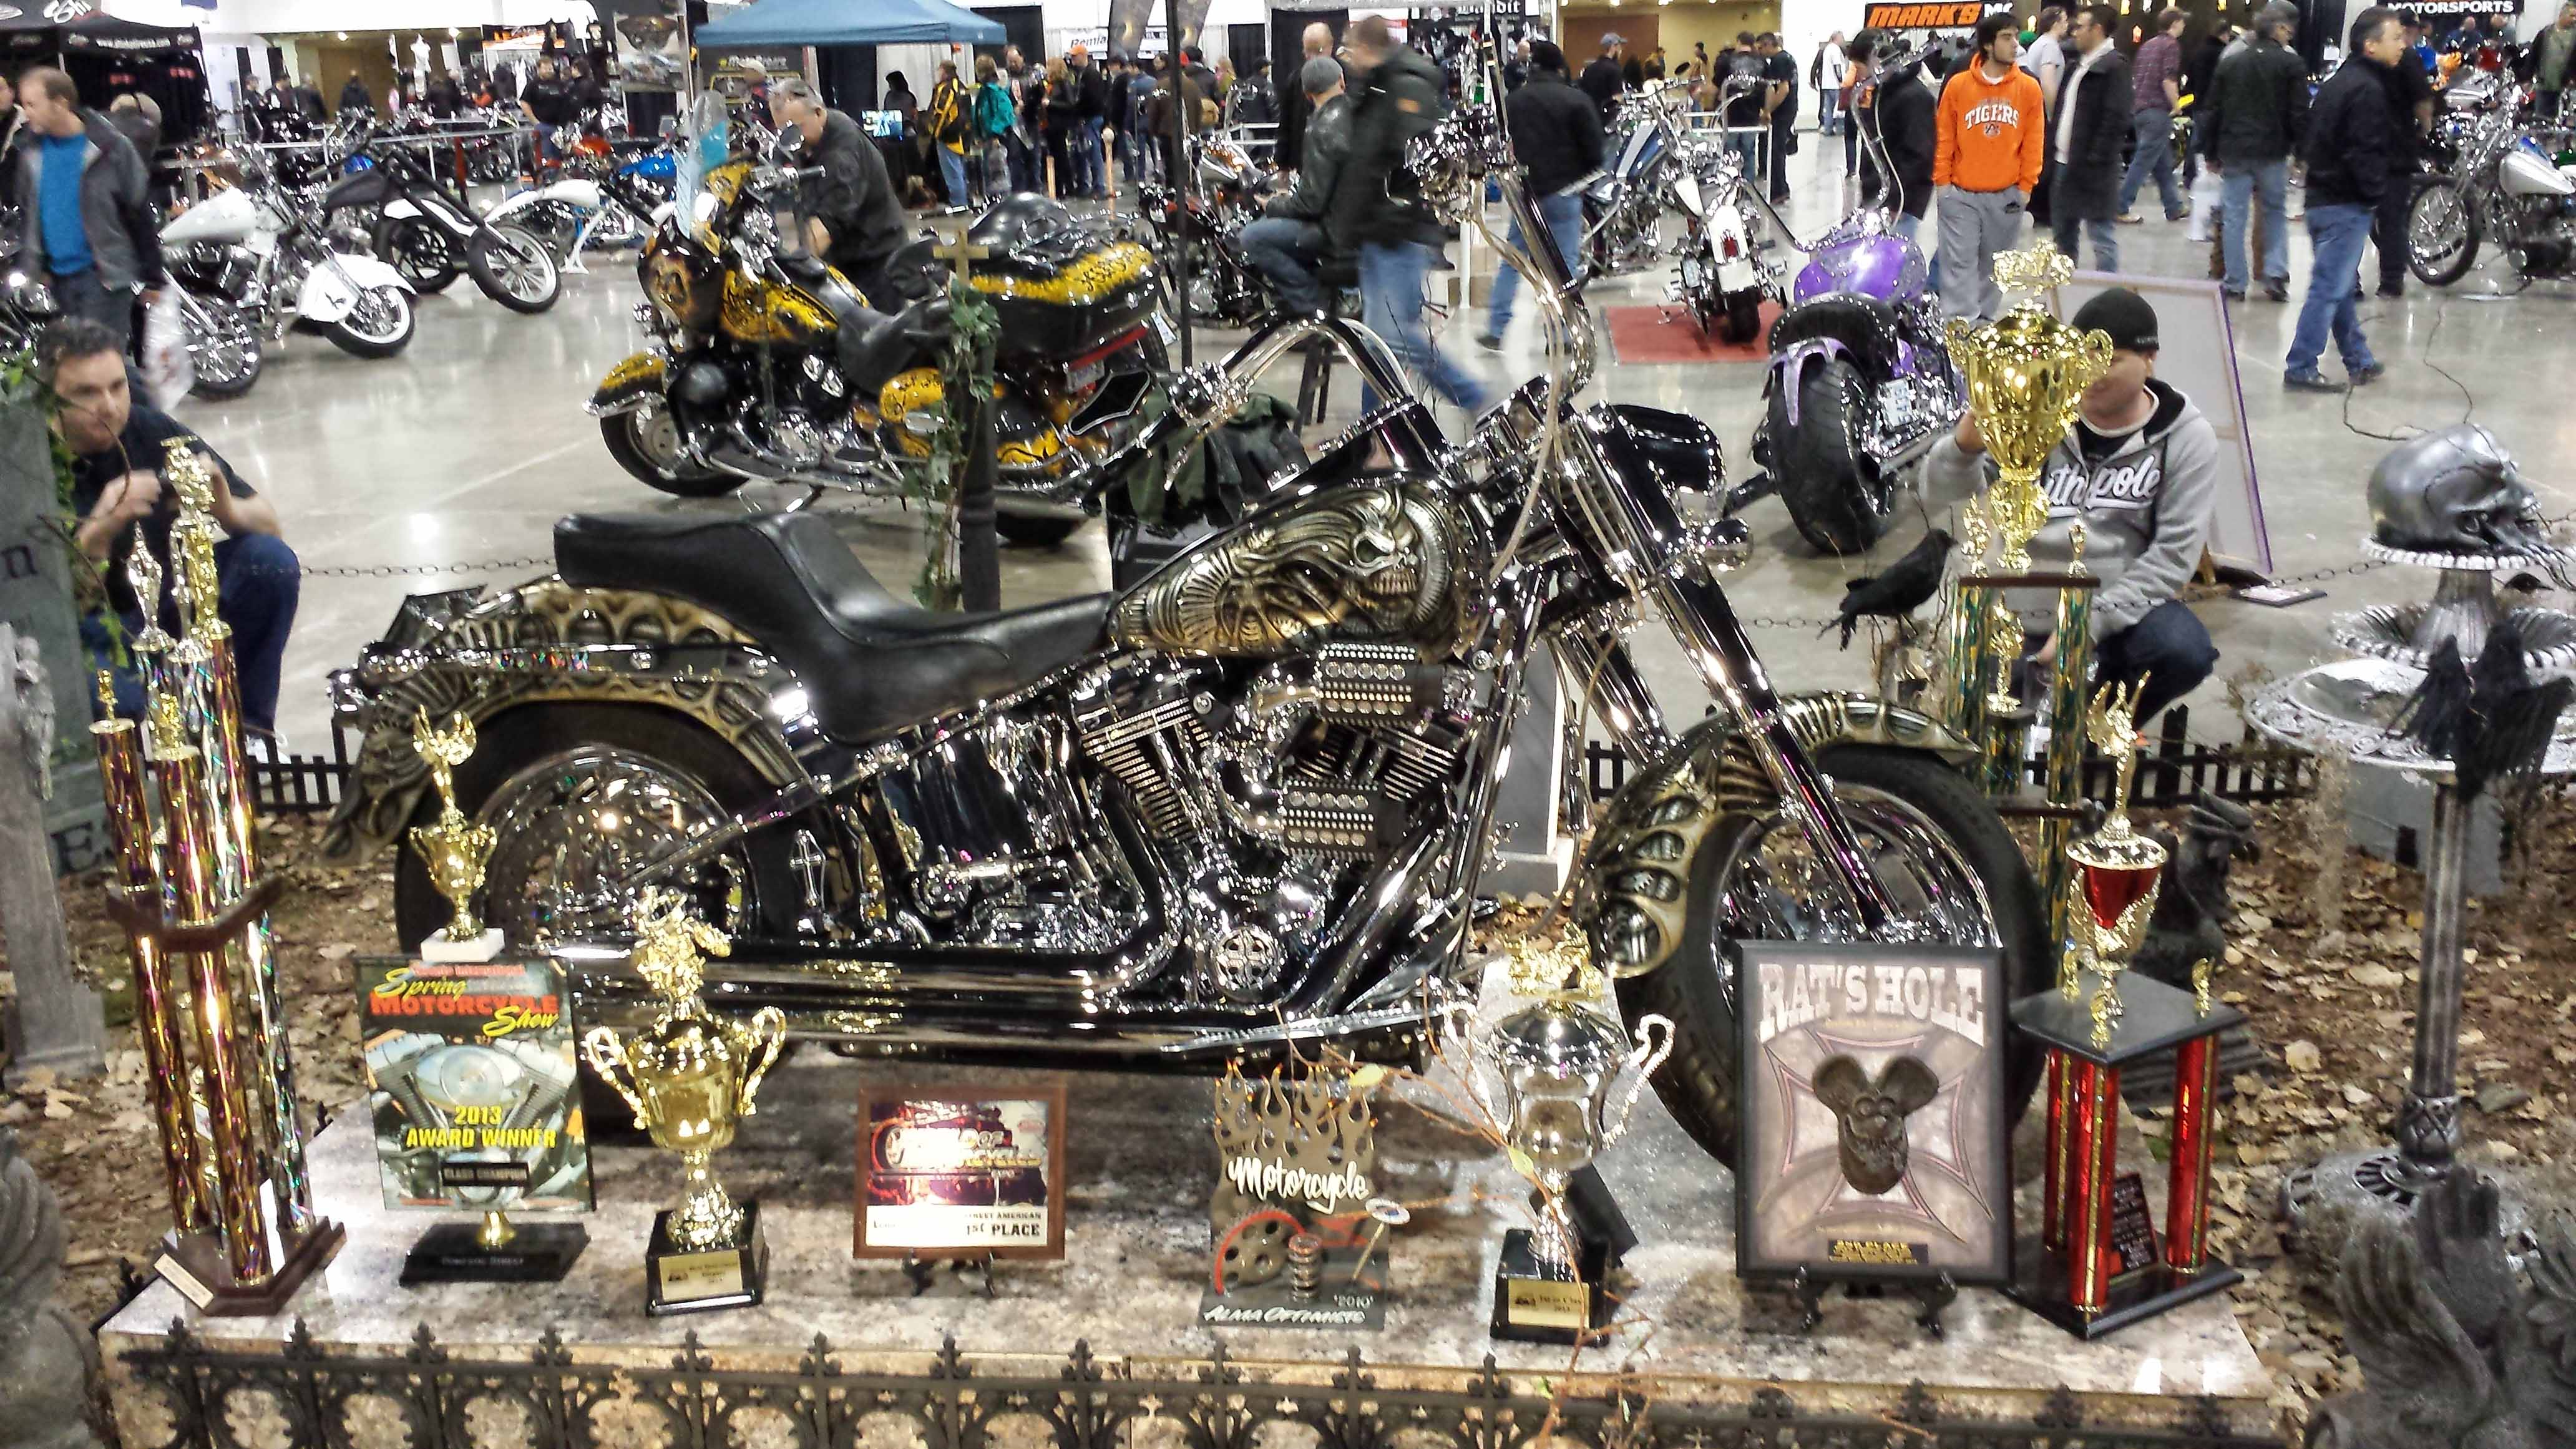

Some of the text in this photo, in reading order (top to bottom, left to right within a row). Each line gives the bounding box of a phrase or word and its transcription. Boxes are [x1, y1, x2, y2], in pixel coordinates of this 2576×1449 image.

[1964, 104, 2019, 130] TIGERS
[375, 968, 466, 1001] Spring
[369, 995, 559, 1016] MOTORCYCLE
[1759, 964, 1984, 1047] RAT'S HOLE
[483, 1005, 559, 1037] Show
[454, 1105, 502, 1125] 2013
[406, 1128, 557, 1149] AWARD WINNER
[1227, 1156, 1370, 1215] Motorcycle
[991, 1223, 1040, 1237] PLACE
